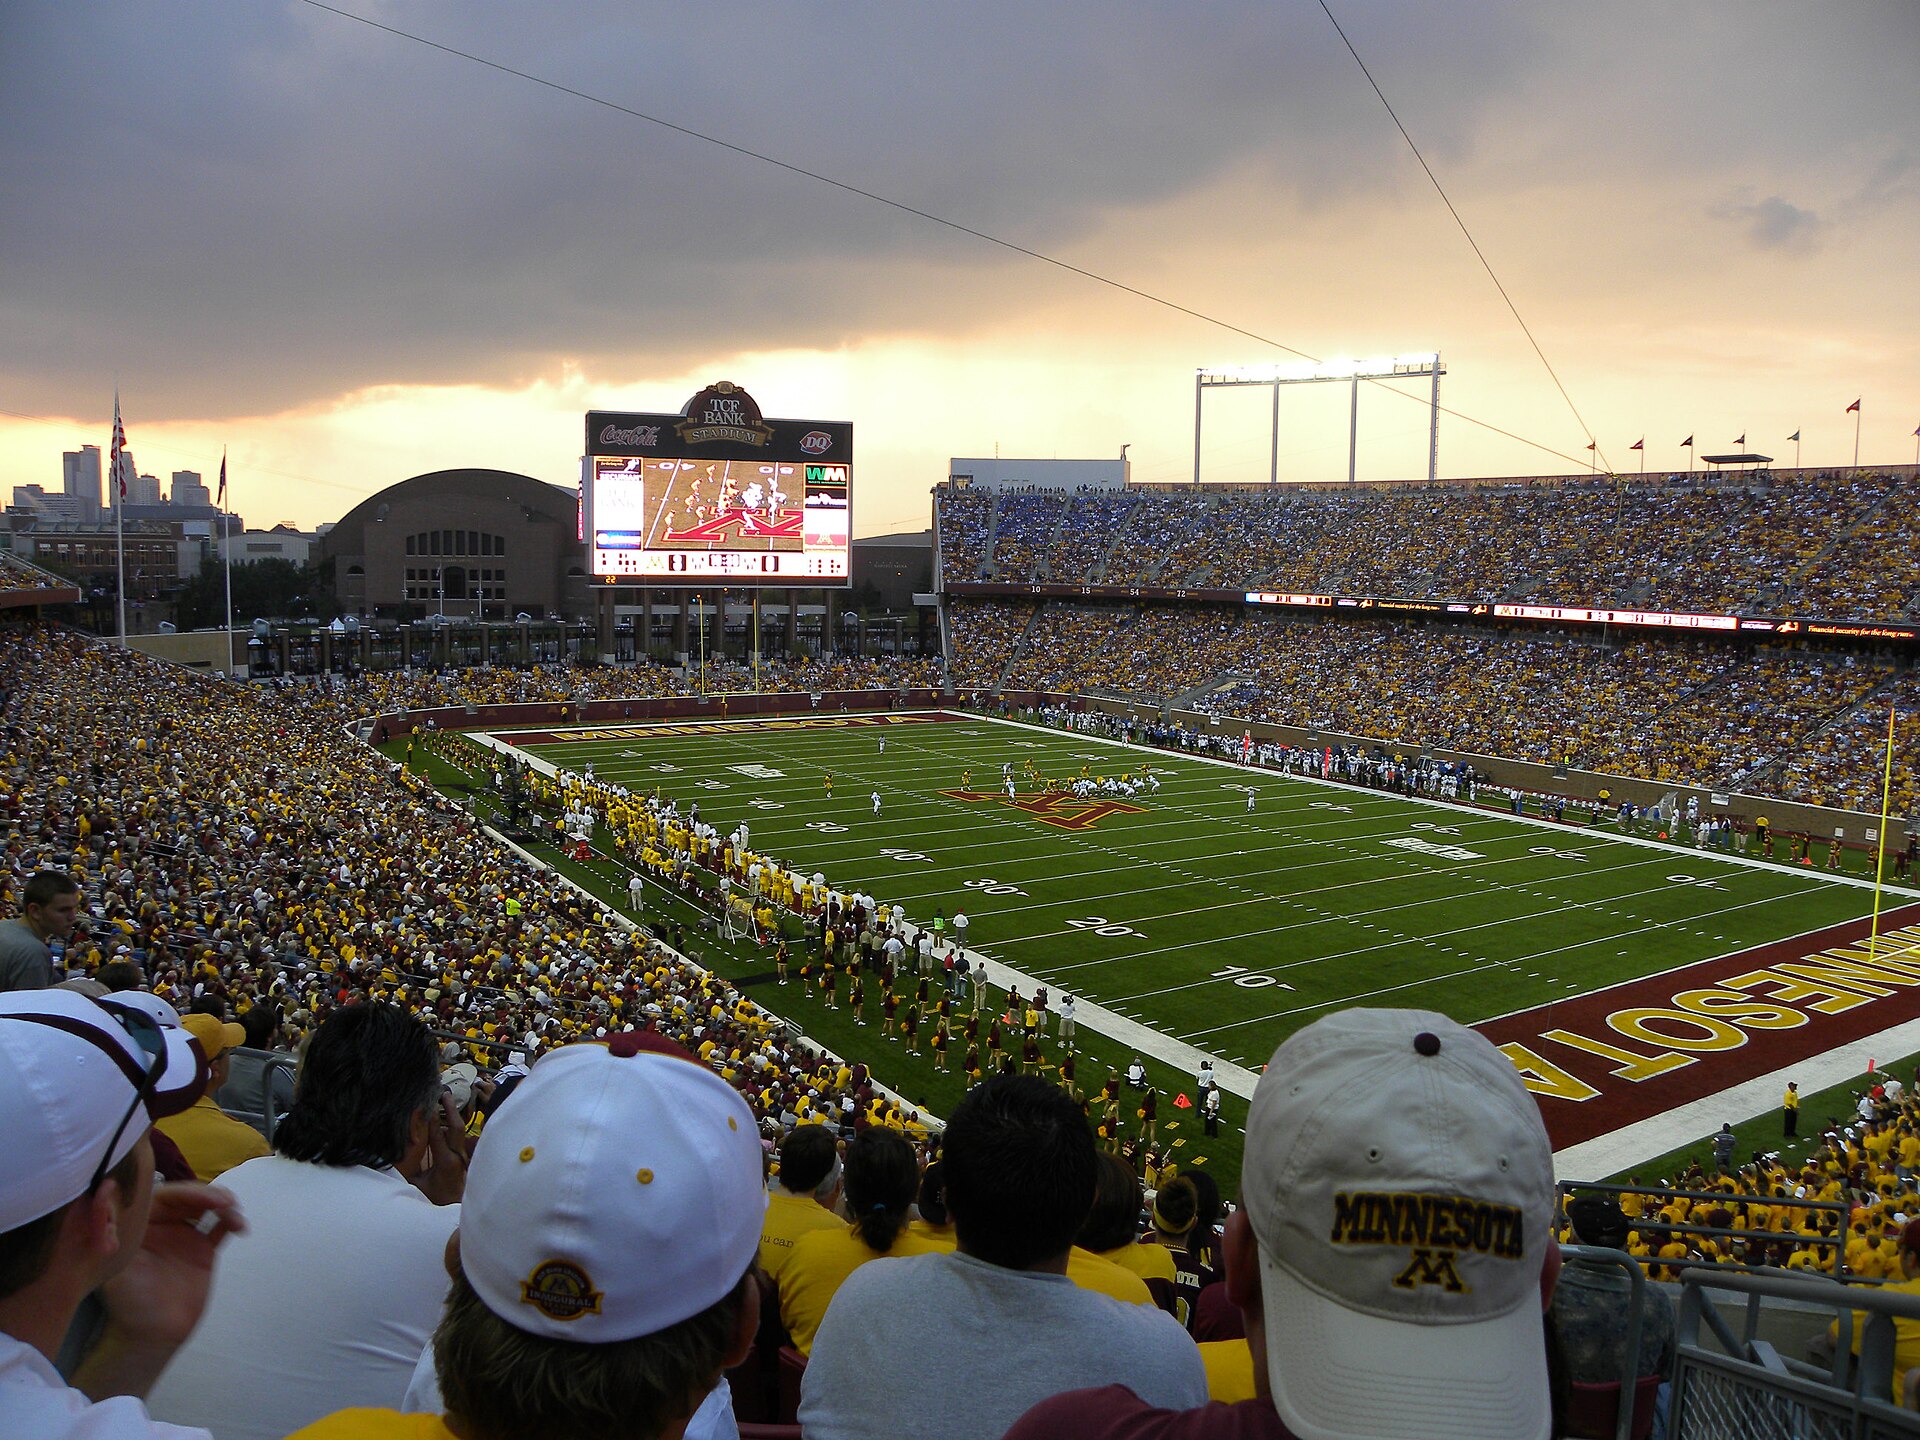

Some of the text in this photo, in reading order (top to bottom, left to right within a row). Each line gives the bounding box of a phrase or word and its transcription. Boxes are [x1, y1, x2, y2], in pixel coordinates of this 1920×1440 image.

[710, 399, 740, 412] TCF
[703, 411, 746, 426] BANK
[600, 424, 661, 446] Coca-Cola
[692, 428, 756, 443] STADIUM
[806, 436, 829, 450] DQ
[806, 467, 846, 481] WM
[1129, 588, 1139, 596] 54
[1808, 625, 1835, 633] Financial
[1836, 628, 1860, 636] security
[1860, 628, 1870, 636] for
[1881, 629, 1896, 638] long
[550, 714, 935, 741] MINNESOTA
[805, 821, 850, 833] 50
[879, 848, 927, 861] 40
[962, 878, 1020, 895] 30
[1065, 916, 1134, 936] 20
[1210, 965, 1277, 988] 10
[1331, 1192, 1525, 1259] MINNESOTA
[773, 1238, 794, 1248] can
[1392, 1249, 1465, 1293] M
[529, 1289, 592, 1306] INAUGURAL
